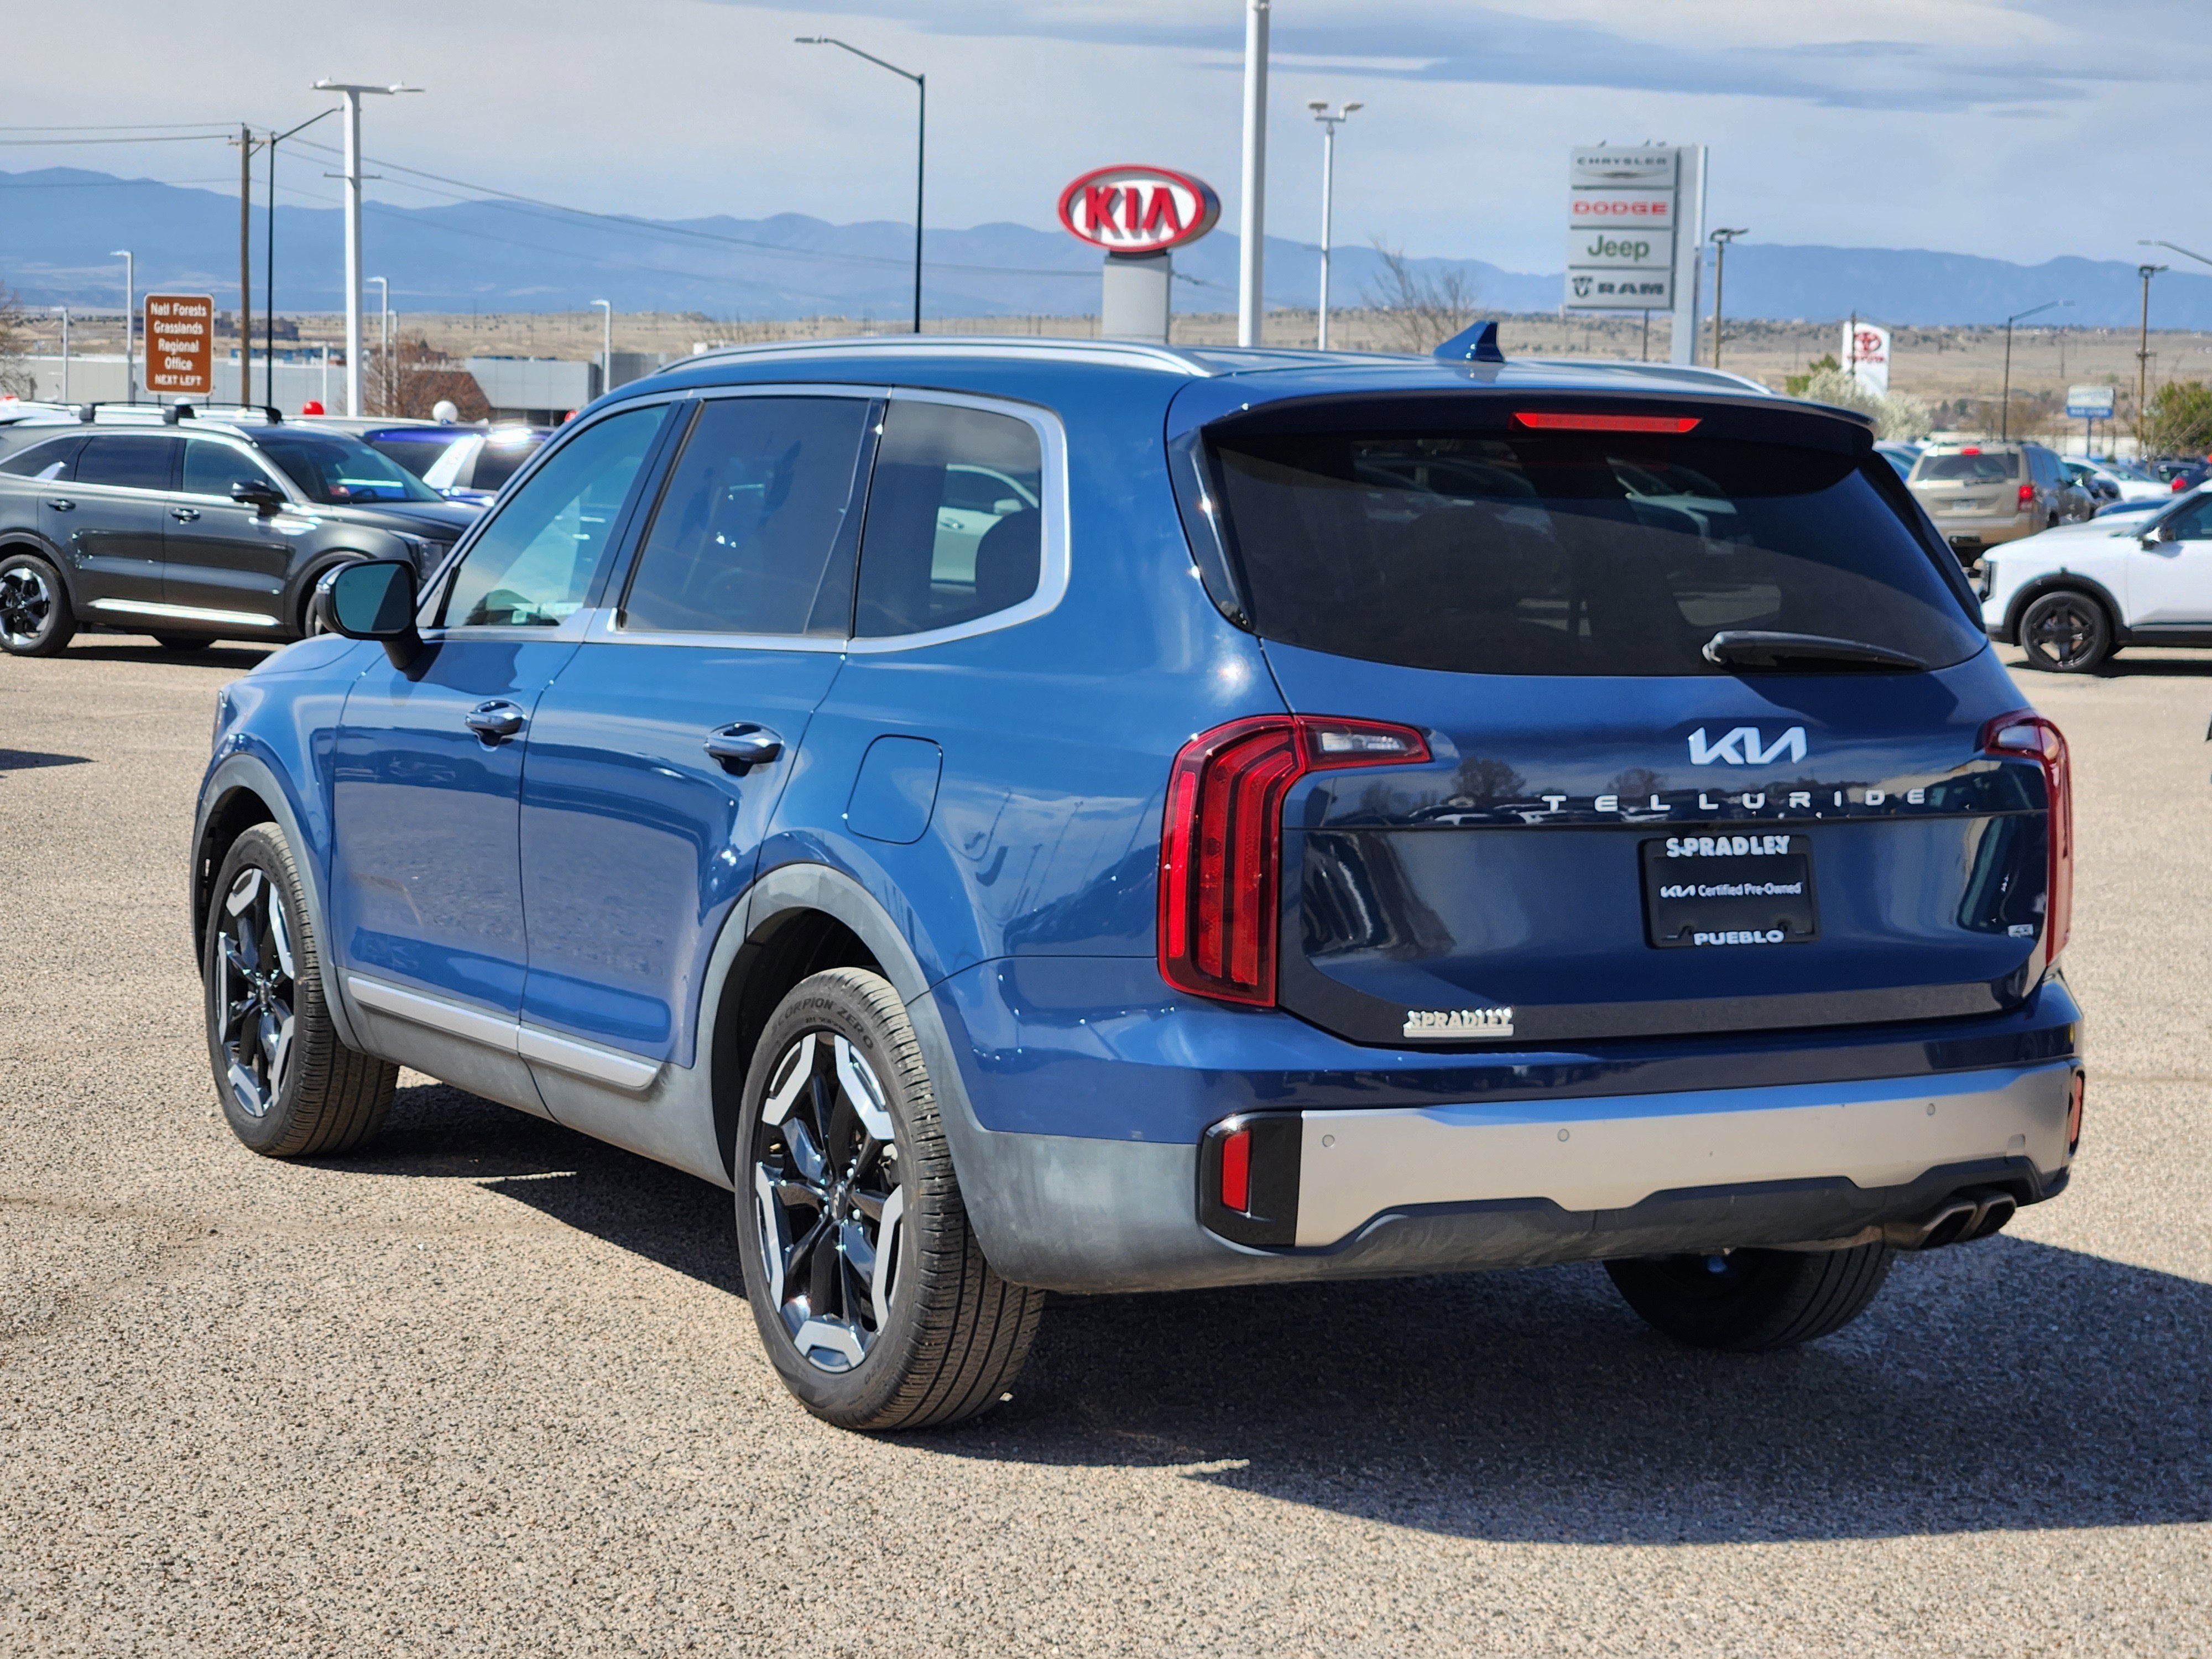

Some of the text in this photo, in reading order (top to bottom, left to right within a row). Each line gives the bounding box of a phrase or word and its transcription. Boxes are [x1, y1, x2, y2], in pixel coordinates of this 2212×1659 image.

[1577, 156, 1667, 165] CHRYSLER
[1084, 185, 1181, 232] KIA
[1573, 201, 1667, 216] DODGE
[1587, 234, 1650, 262] Jeep
[1598, 283, 1664, 294] RAM
[173, 302, 207, 317] Forests
[154, 320, 204, 335] Grasslands
[158, 338, 200, 355] Regional
[164, 357, 193, 371] Office
[155, 374, 202, 386] NEXT LEFT
[1689, 727, 1807, 765] KIA
[1542, 787, 1925, 812] TELLURIDE
[1666, 835, 1790, 857] SPRADLEY
[1660, 882, 1802, 898] KIA Certified Pre-Owned
[1693, 930, 1785, 946] PUEBLO
[1404, 1008, 1512, 1029] SPRADLEY
[836, 1006, 874, 1049] ZERO
